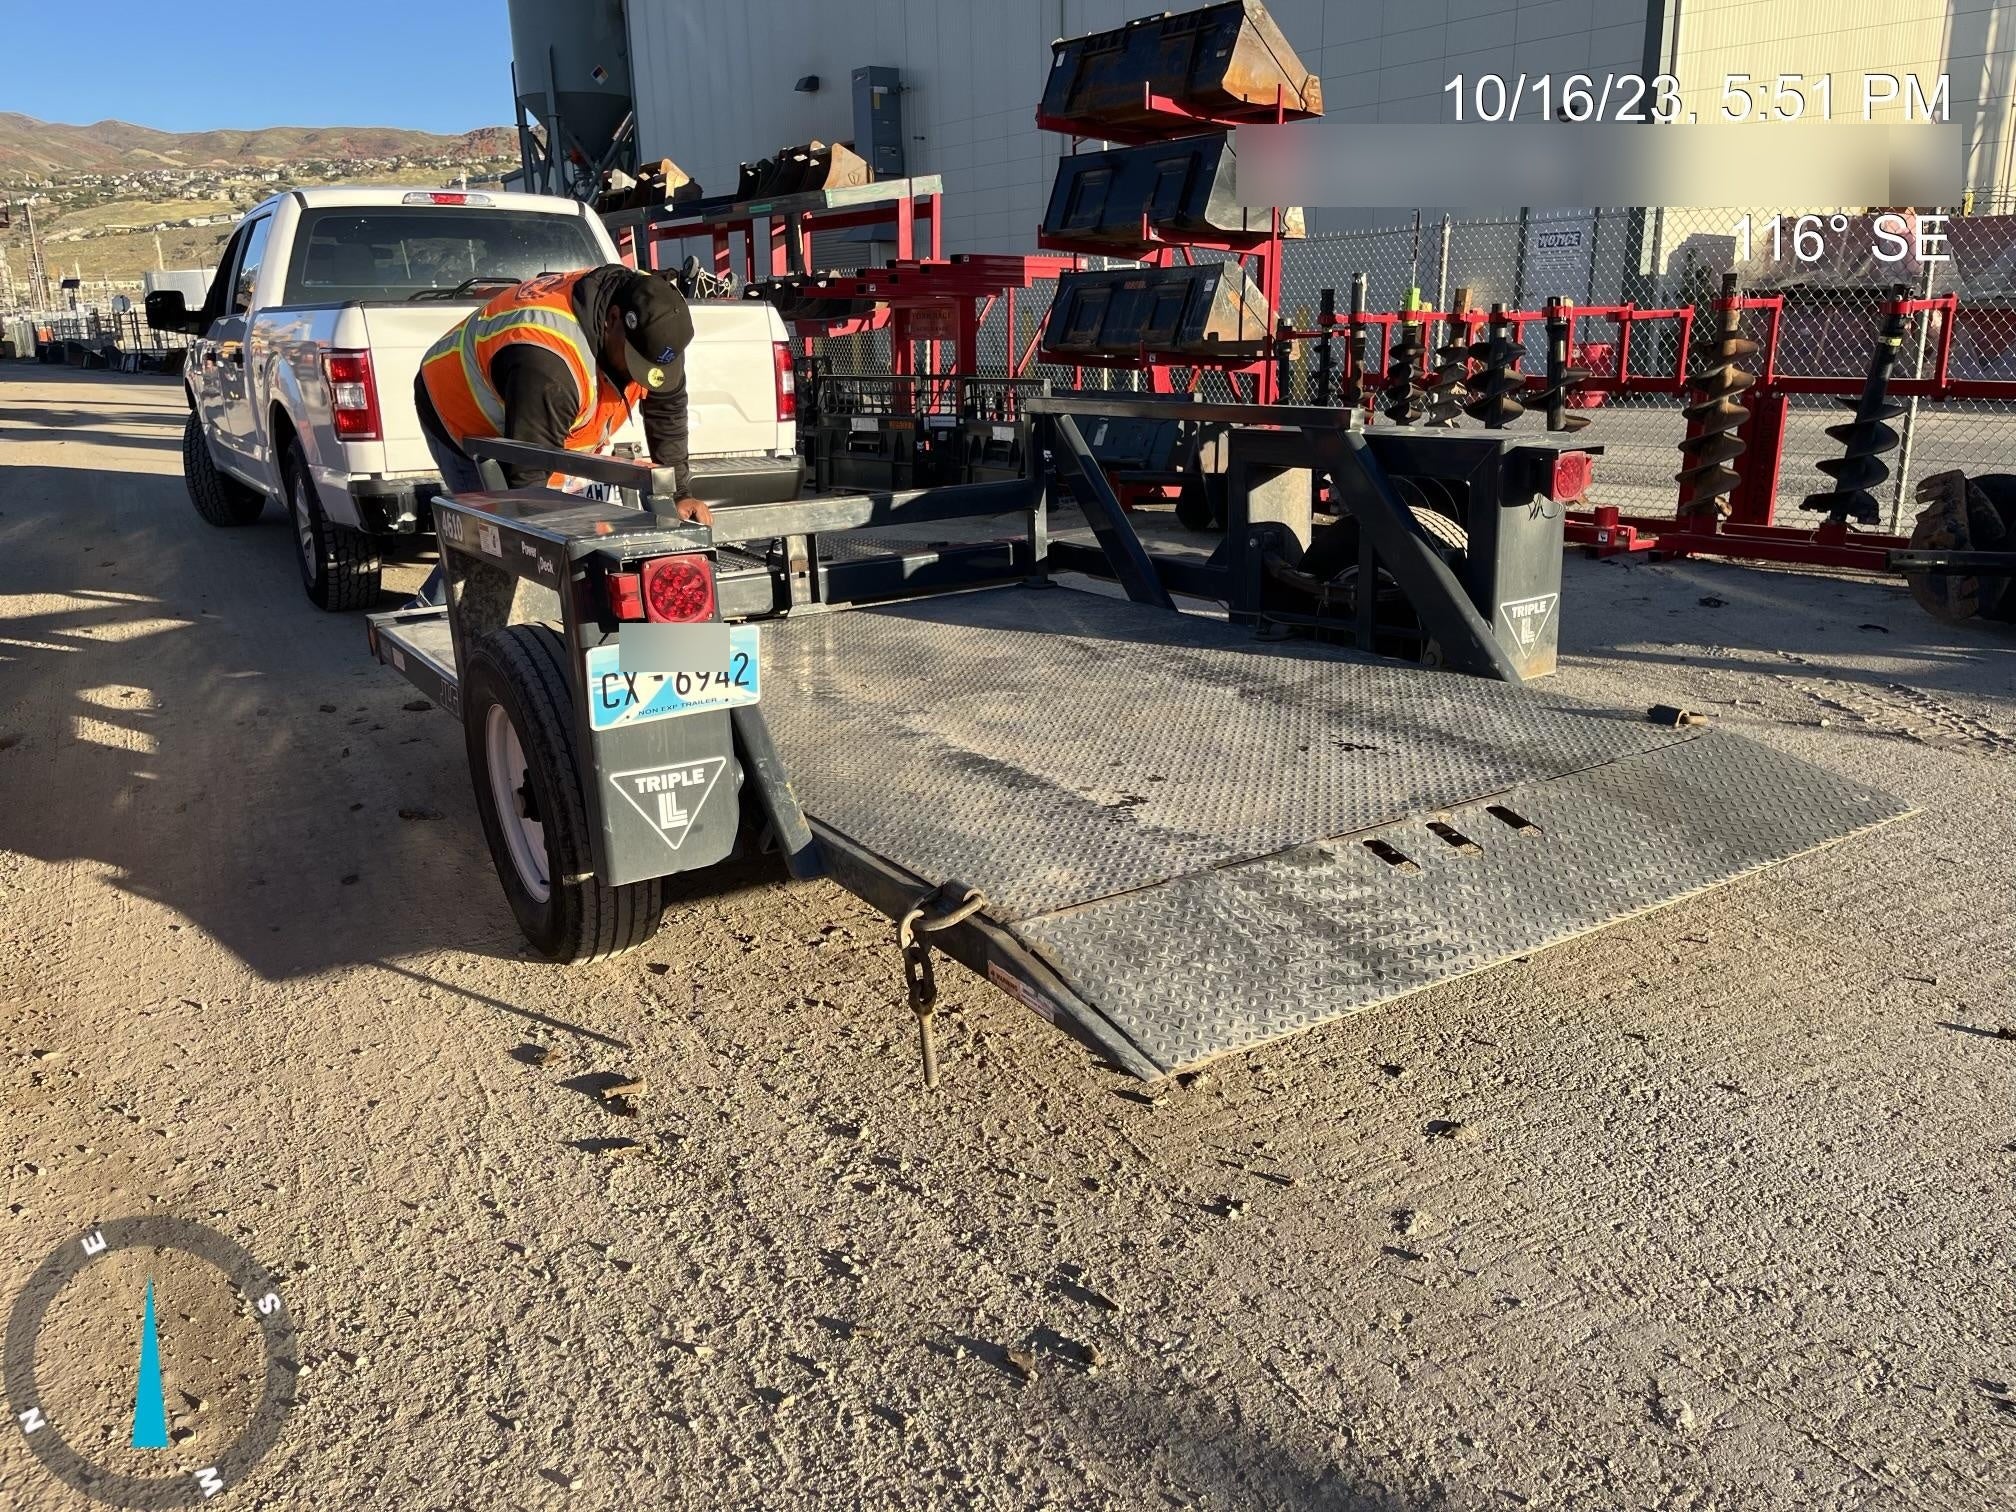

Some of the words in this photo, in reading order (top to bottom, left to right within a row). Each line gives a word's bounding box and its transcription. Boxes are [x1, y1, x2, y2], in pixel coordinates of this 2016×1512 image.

[1538, 232, 1580, 247] NOTICE
[442, 511, 463, 542] 4610
[521, 540, 537, 558] Power
[539, 556, 555, 575] Deck
[1511, 600, 1547, 619] TRIPLE
[661, 704, 679, 712] EXP
[681, 697, 717, 708] TRAILER
[634, 767, 705, 794] TRIPLE
